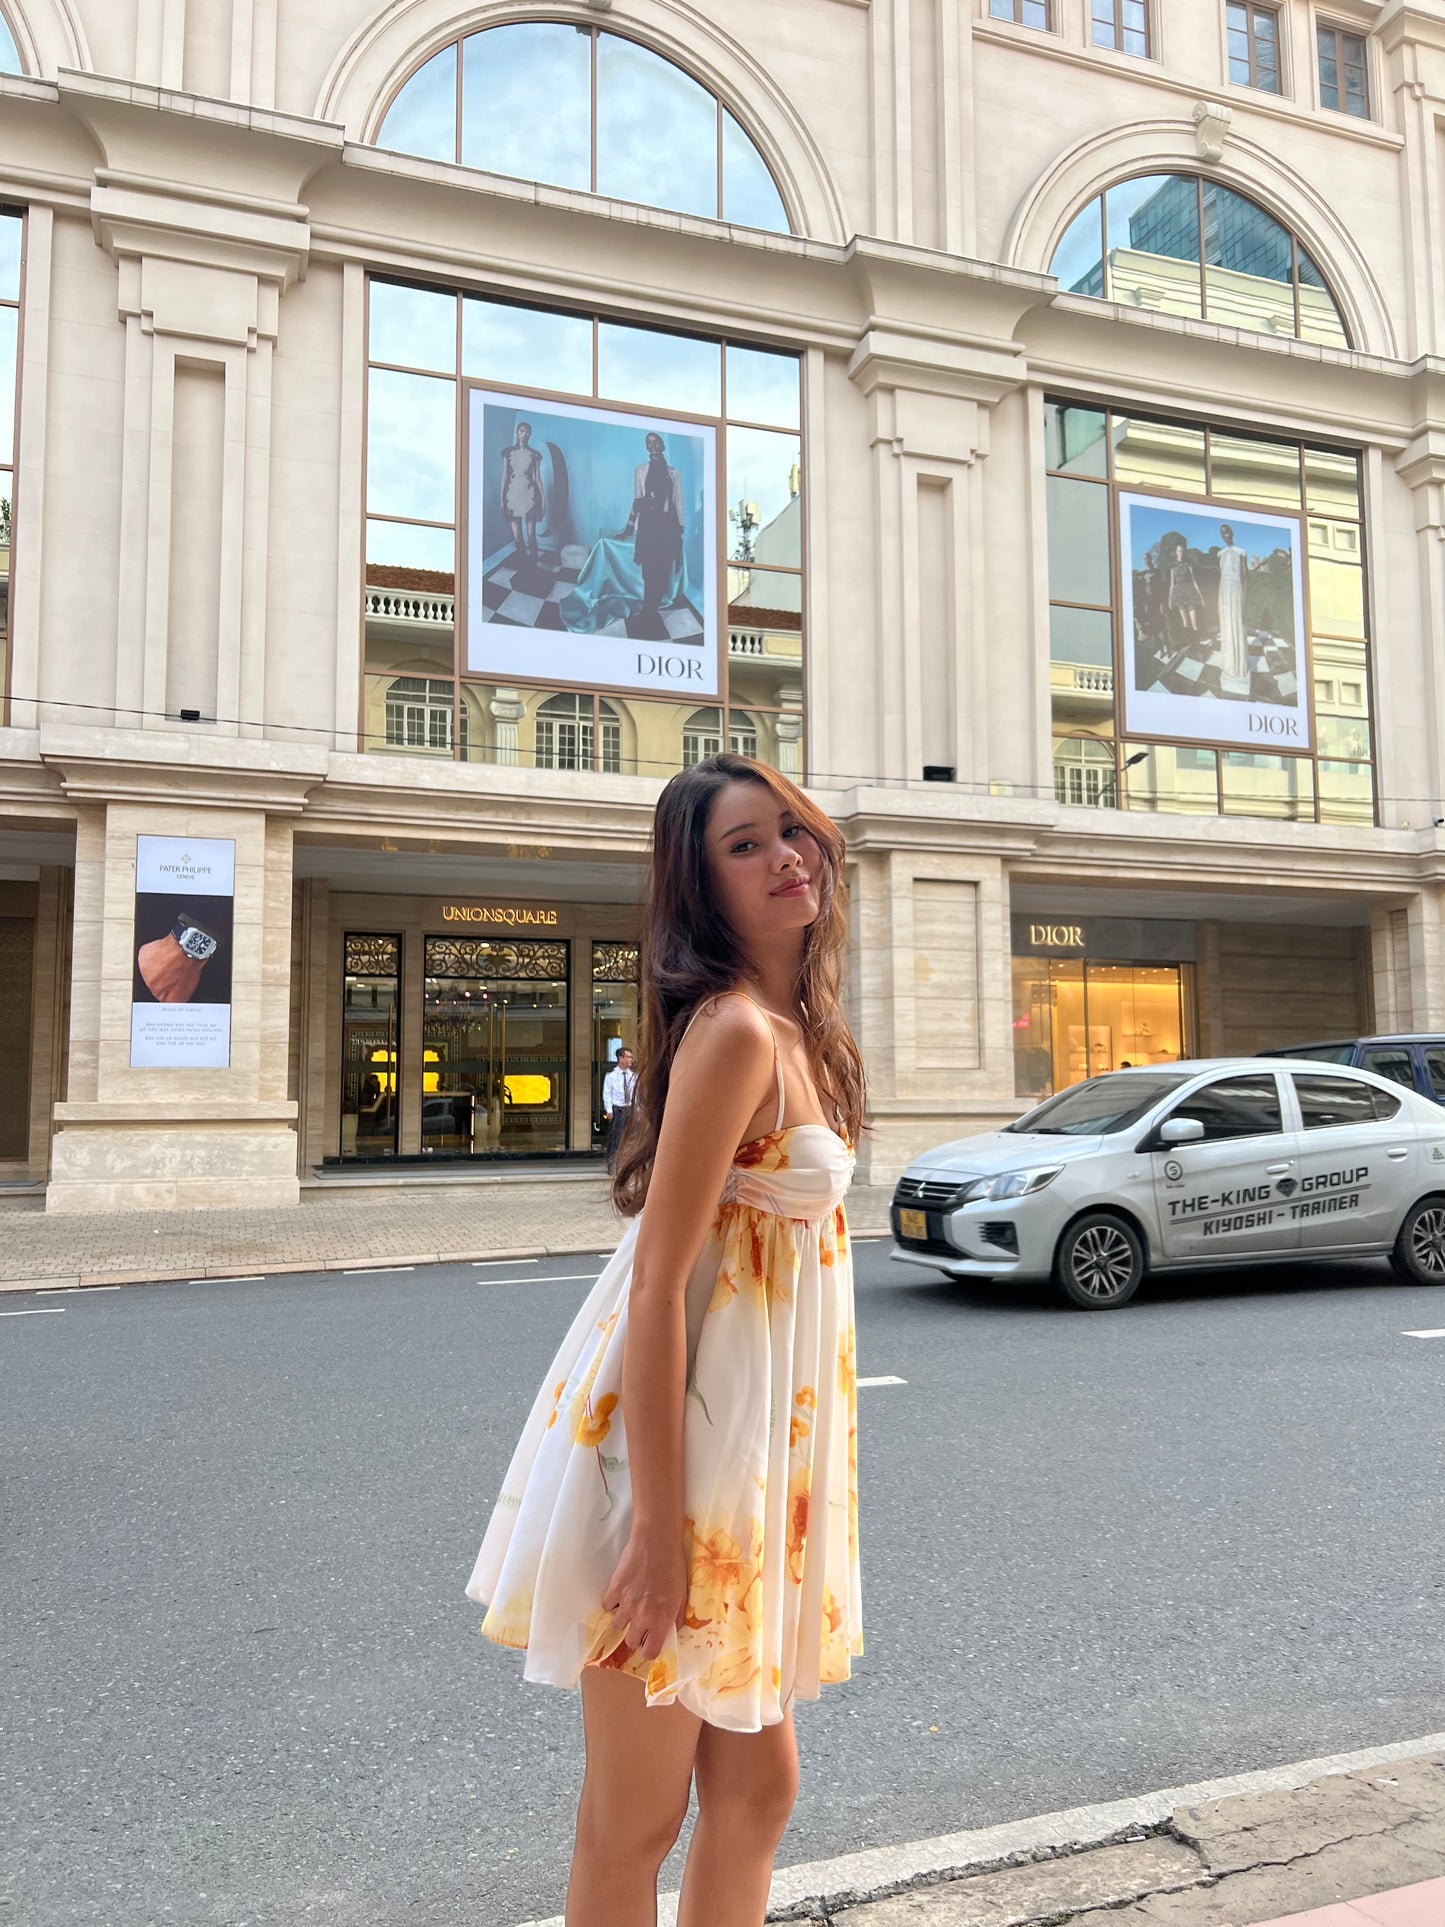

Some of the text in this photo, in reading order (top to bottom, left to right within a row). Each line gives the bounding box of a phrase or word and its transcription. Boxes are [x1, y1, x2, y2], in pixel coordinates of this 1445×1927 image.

[635, 654, 704, 681] DIOR
[1248, 714, 1299, 737] DIOR
[159, 865, 181, 873] PATEK
[443, 906, 557, 926] UNIONSQUARE
[1031, 925, 1085, 946] DIOR
[1168, 1167, 1369, 1216] THE-KING GROUP
[1203, 1210, 1273, 1236] KIYOSHI
